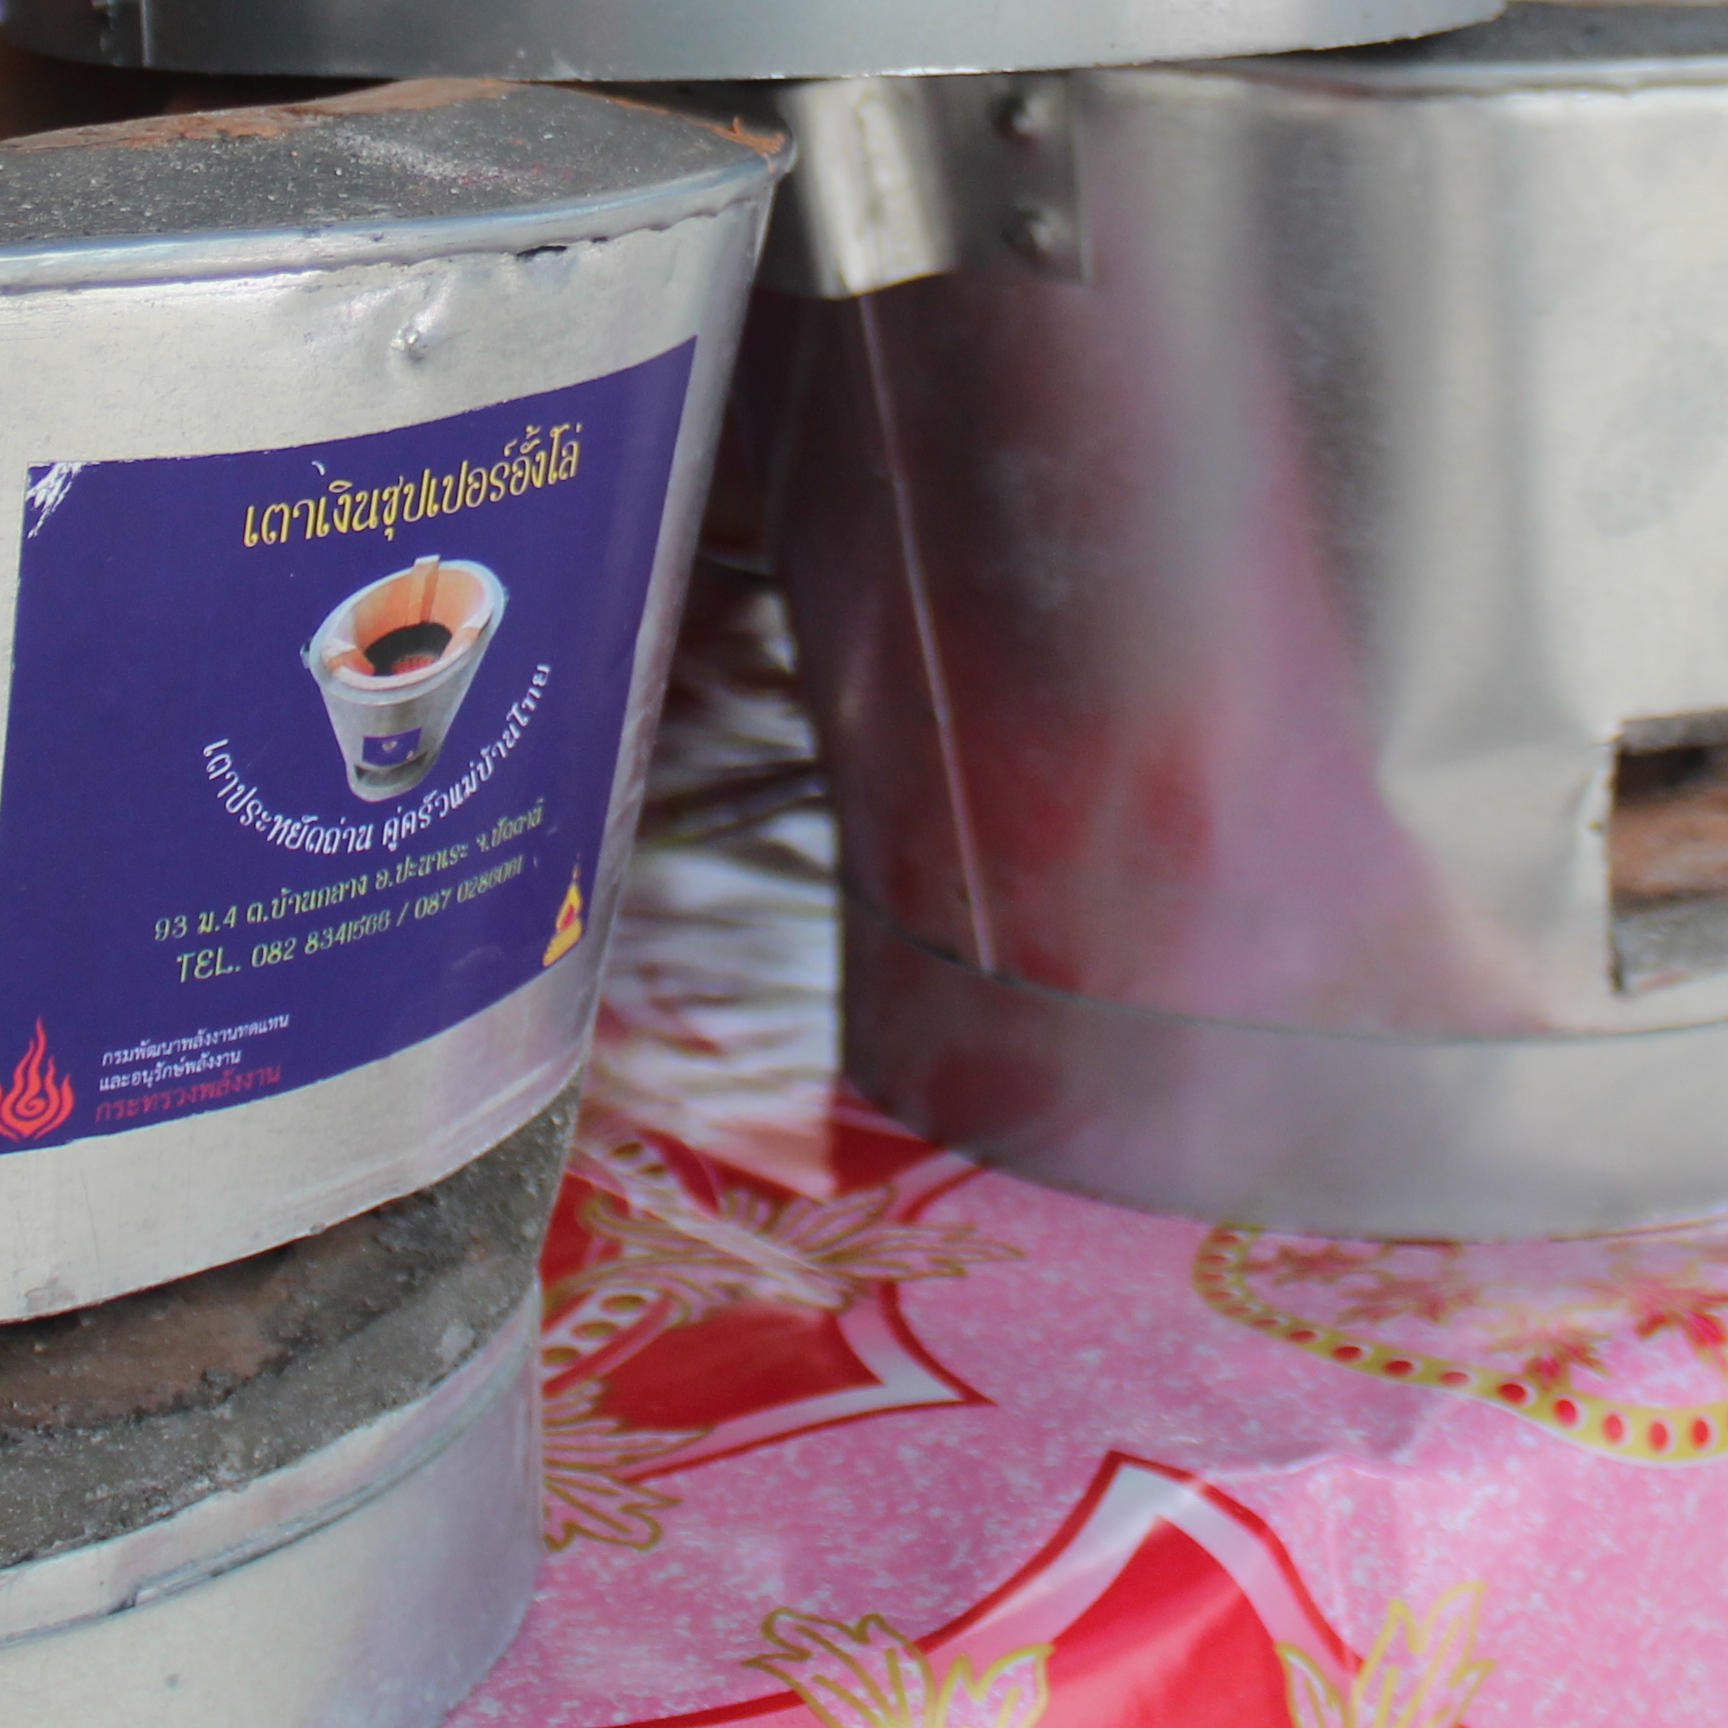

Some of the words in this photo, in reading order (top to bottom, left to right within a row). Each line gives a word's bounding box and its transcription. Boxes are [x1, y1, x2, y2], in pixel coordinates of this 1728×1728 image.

[243, 423, 582, 547] เตาเงินซุปเปอร์อั้งโล่
[203, 739, 373, 854] เตาประหยัดถ่าน
[155, 915, 188, 941] 93
[197, 906, 236, 934] ม.4
[247, 874, 368, 924] ต.บ้านกลาง
[375, 843, 468, 890] อ.ปะนาเระ
[177, 946, 241, 983] TEL.
[251, 938, 296, 968] 082
[396, 902, 409, 927] /
[415, 888, 452, 920] 087
[99, 1050, 241, 1092] และอนุรักษ์พลังงาน
[102, 1014, 289, 1066] กรมพัฒนาพลังงานทดแทน
[95, 1065, 281, 1122] กระทรวงพลังงาน
